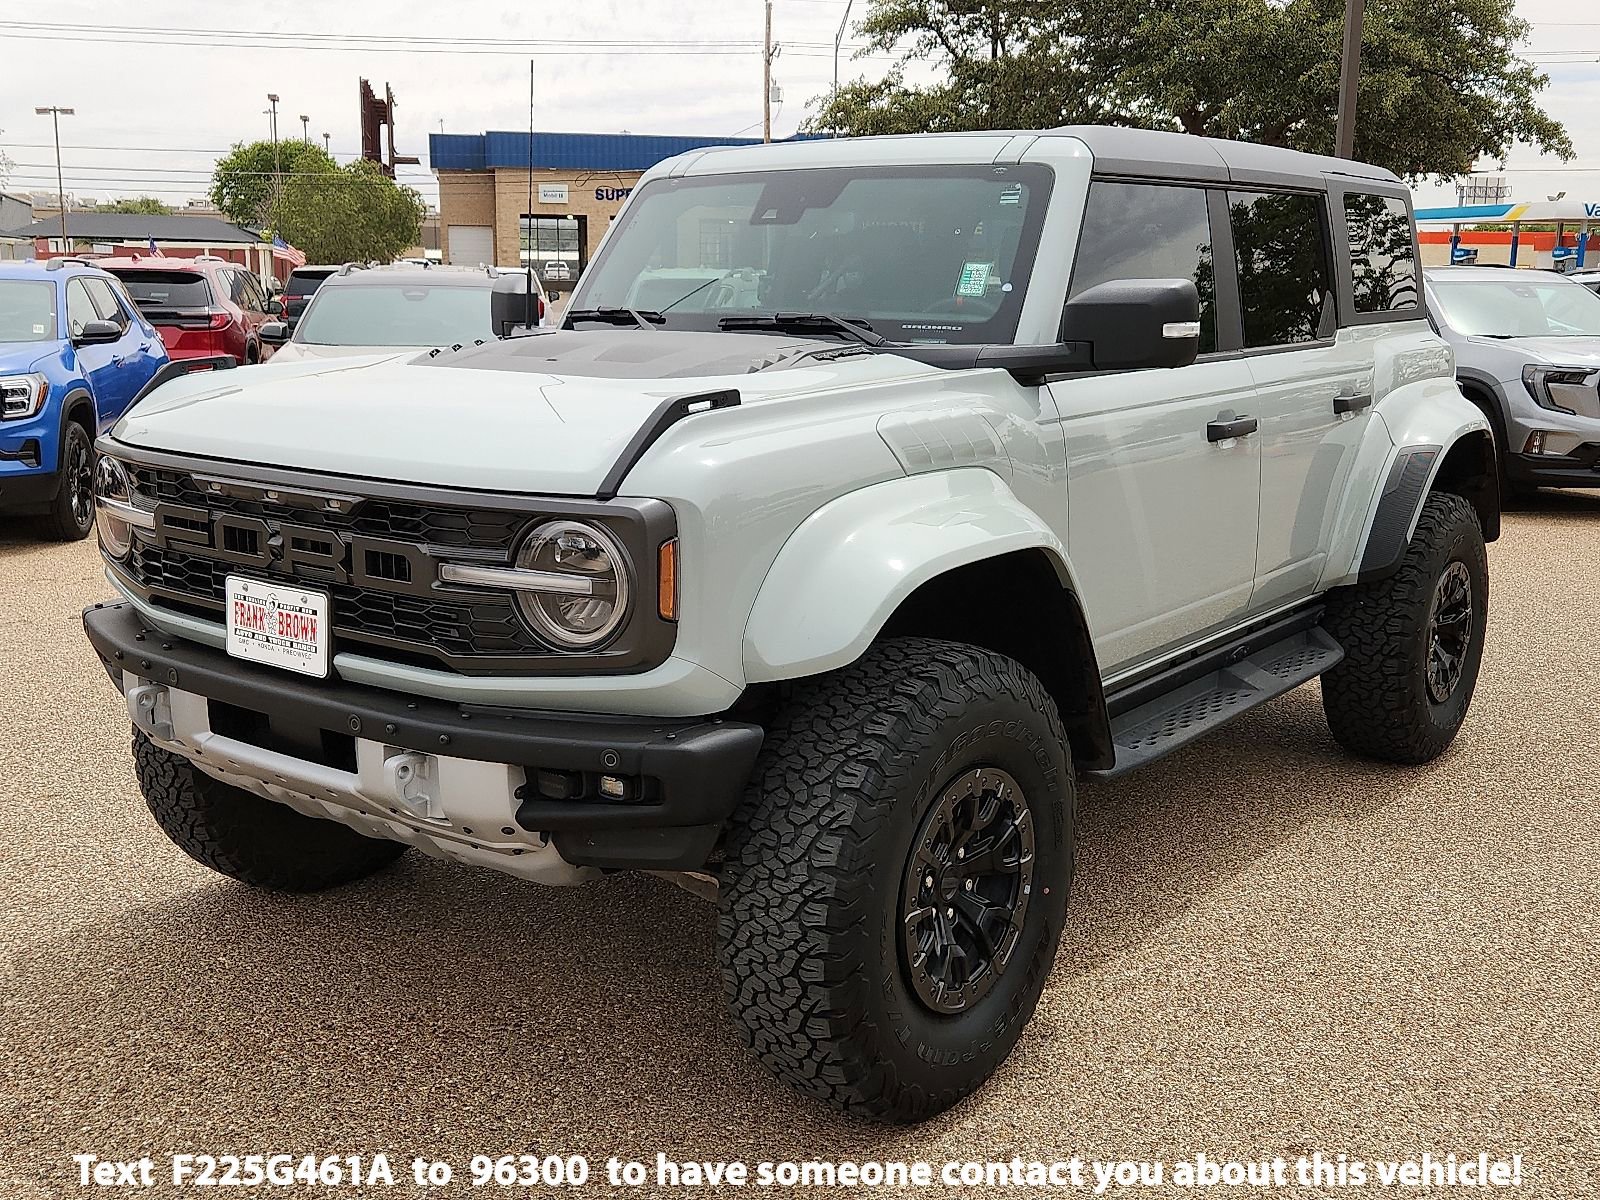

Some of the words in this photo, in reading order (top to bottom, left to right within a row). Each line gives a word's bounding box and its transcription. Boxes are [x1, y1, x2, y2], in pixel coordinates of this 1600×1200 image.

[153, 502, 438, 599] FORD
[279, 603, 301, 612] PROFIT
[234, 601, 266, 633] FRANK
[277, 611, 317, 644] BROWN
[235, 629, 253, 638] AUTO
[253, 633, 267, 642] AND
[267, 636, 291, 648] TRUCK
[292, 642, 316, 654] RANCH
[257, 642, 275, 652] HONDA
